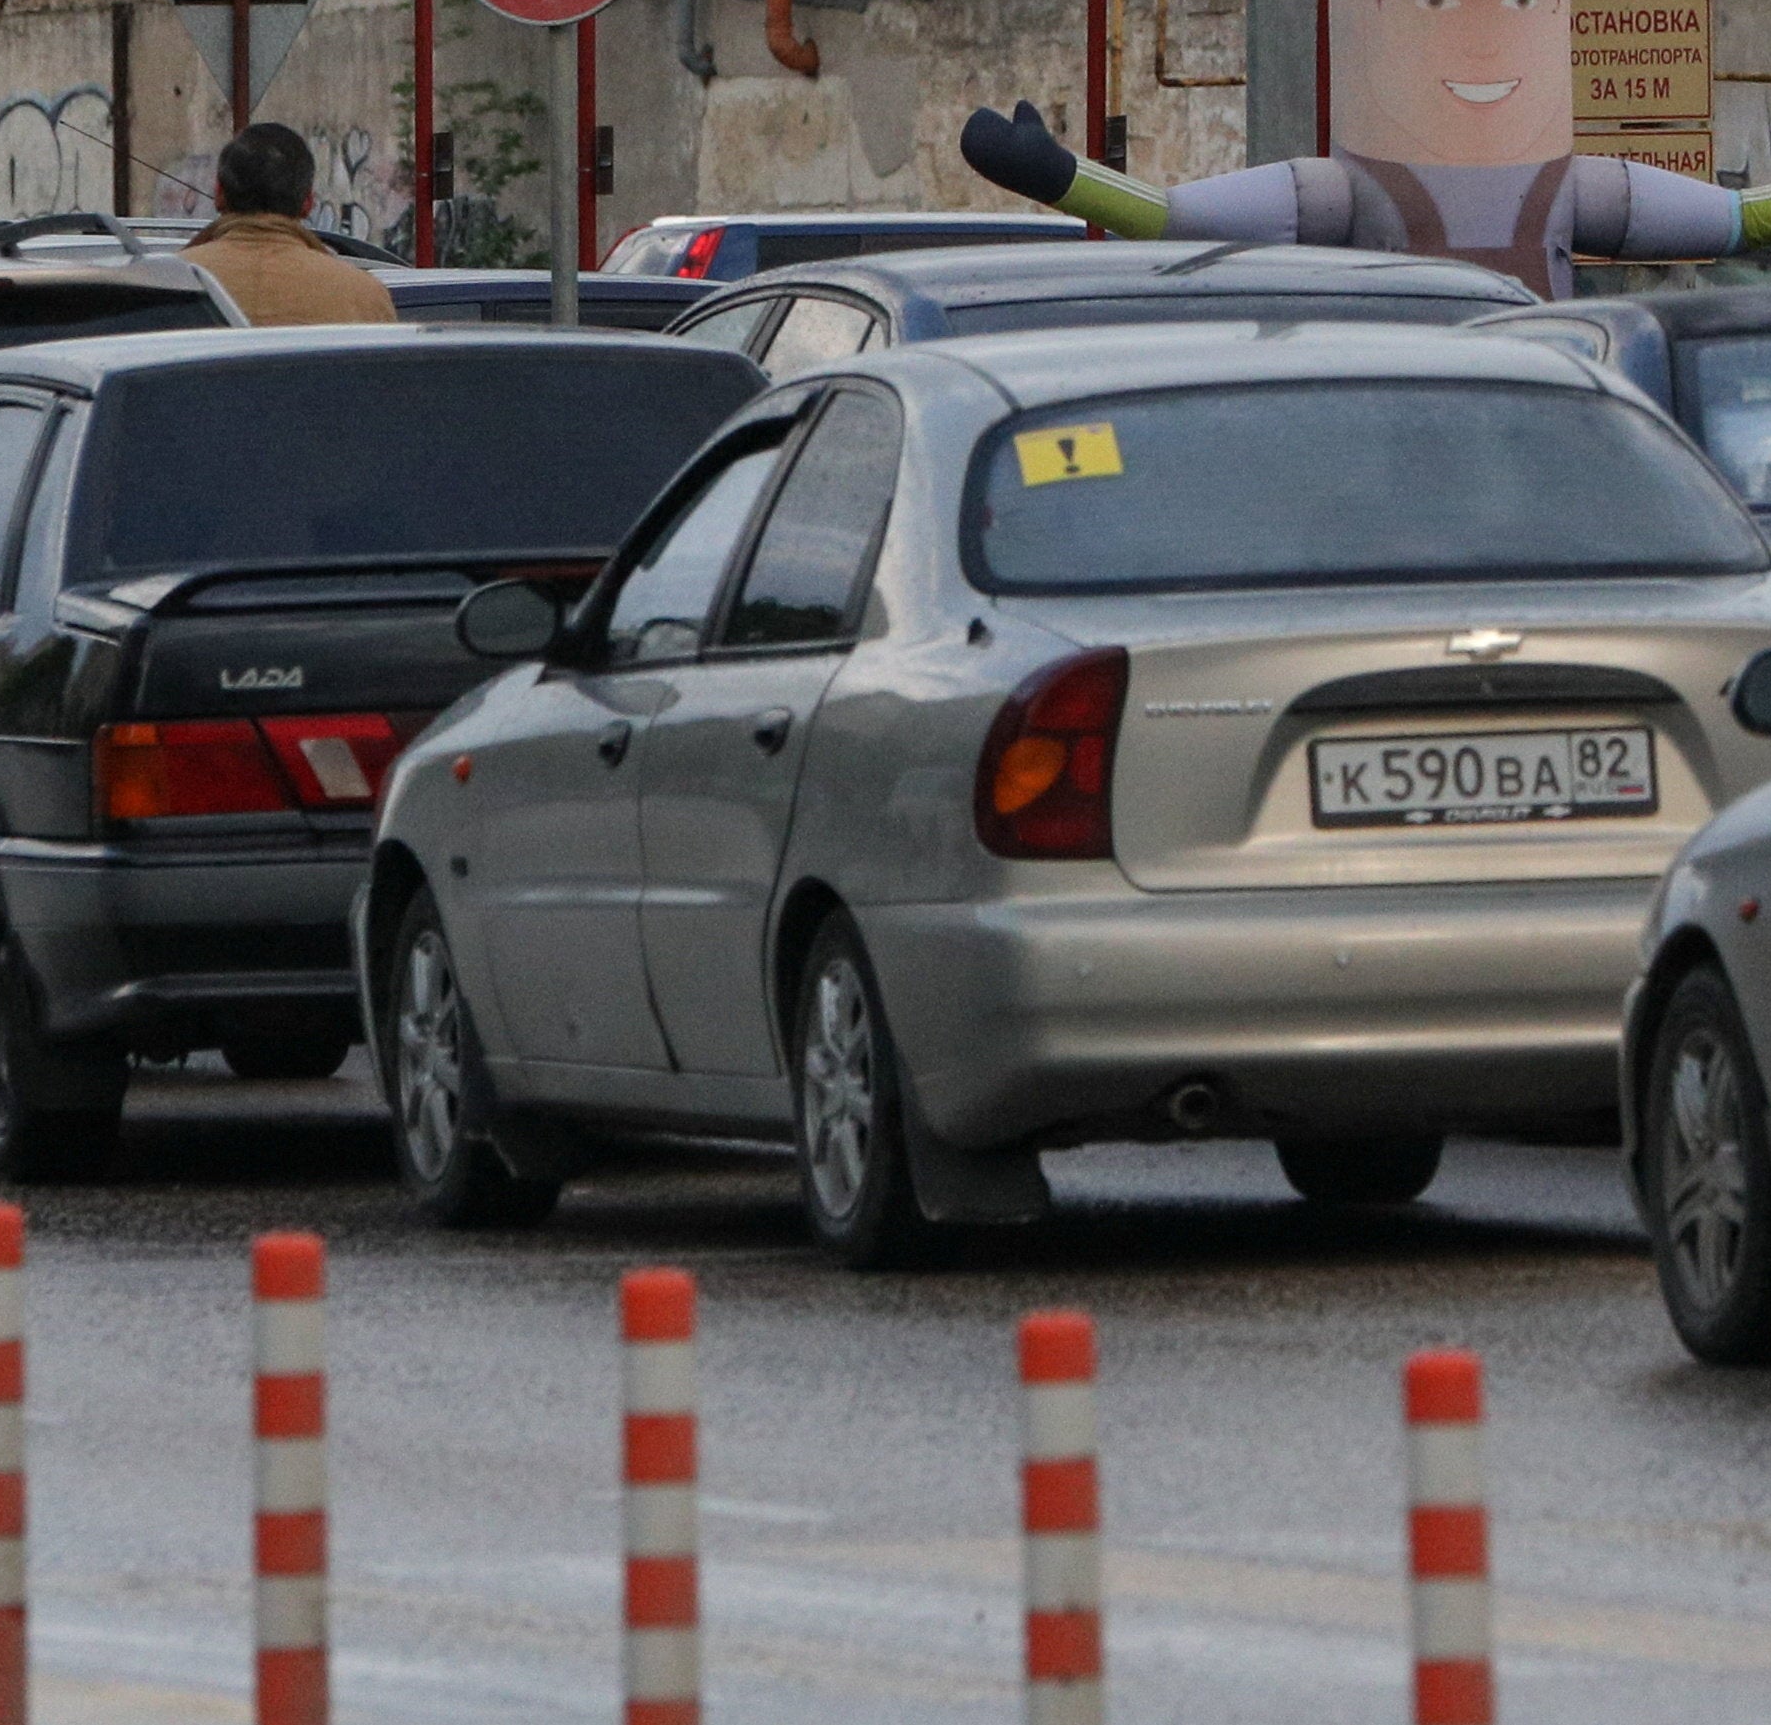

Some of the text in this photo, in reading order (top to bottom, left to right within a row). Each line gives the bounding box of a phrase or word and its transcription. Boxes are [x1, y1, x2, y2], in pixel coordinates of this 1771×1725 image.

[1590, 77, 1670, 100] ЗА 15 М
[220, 664, 303, 690] LADA
[1578, 736, 1630, 779] 82
